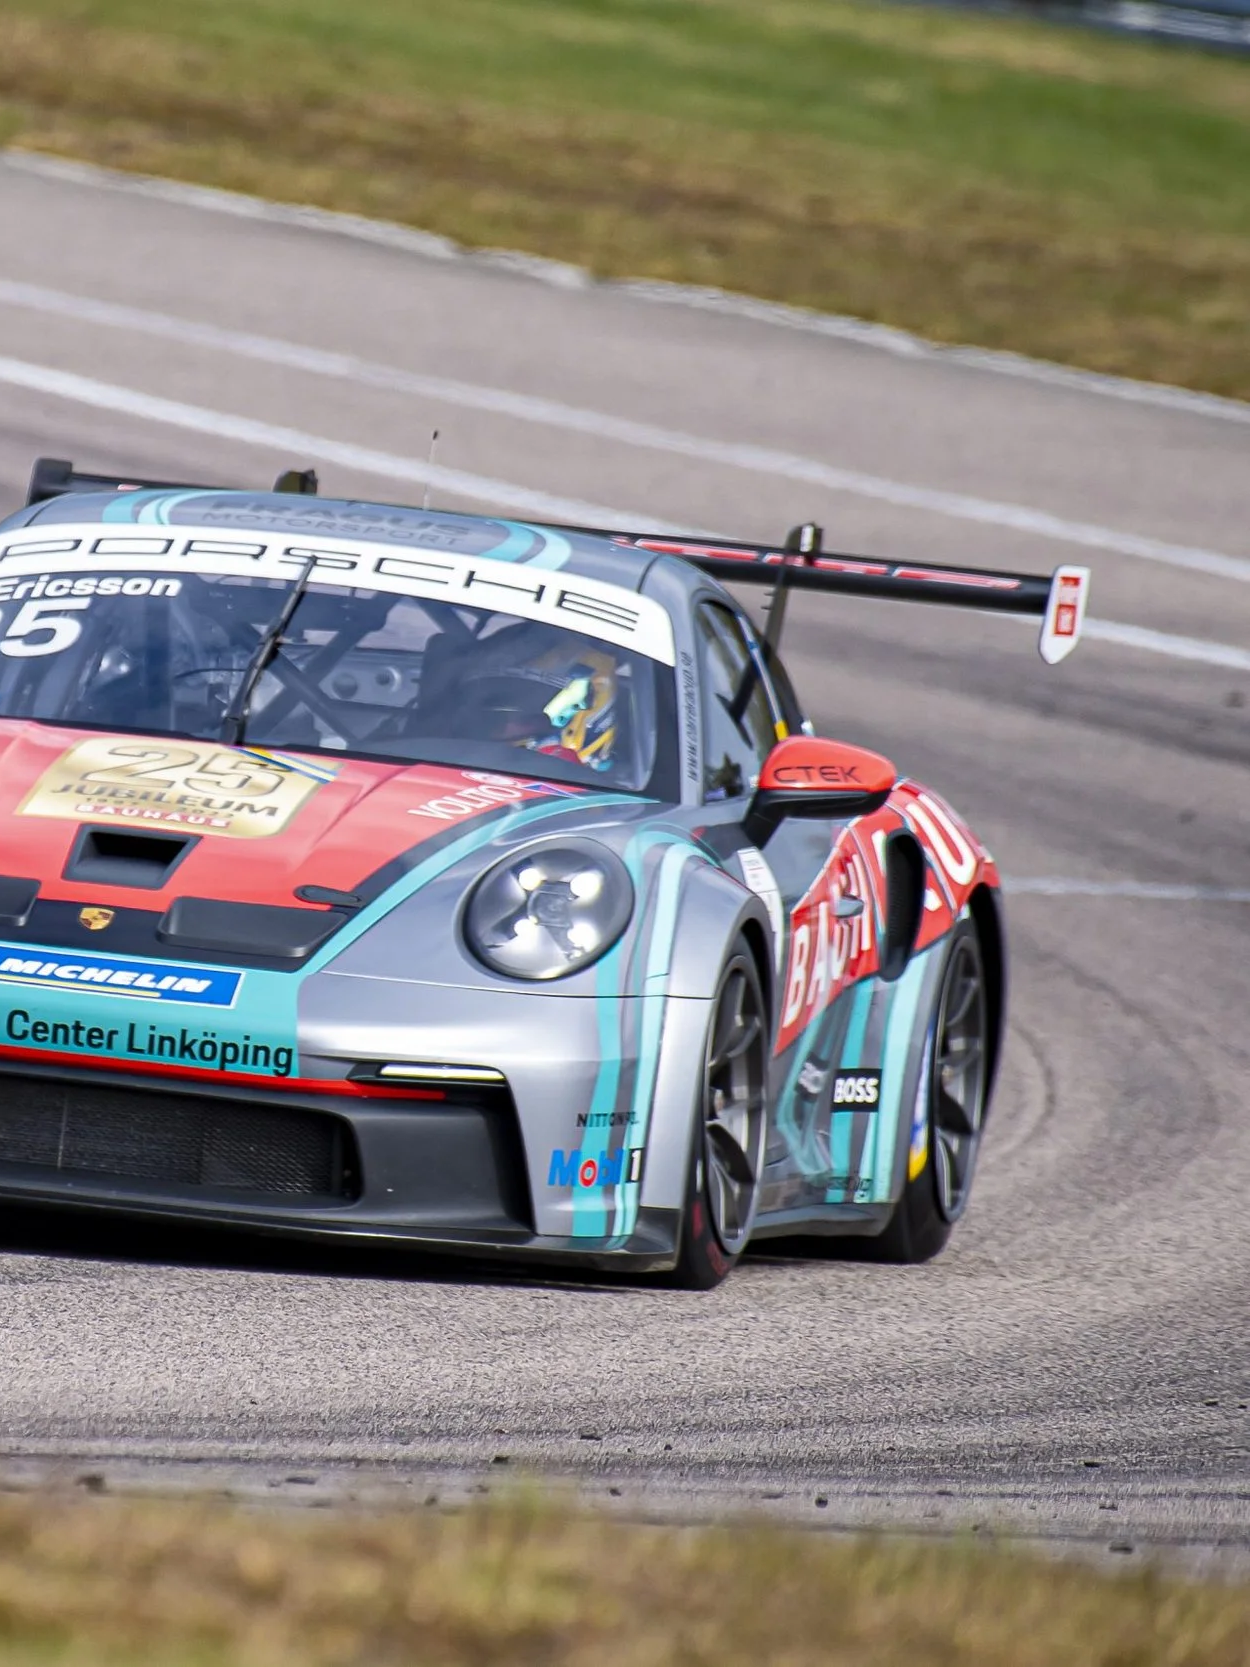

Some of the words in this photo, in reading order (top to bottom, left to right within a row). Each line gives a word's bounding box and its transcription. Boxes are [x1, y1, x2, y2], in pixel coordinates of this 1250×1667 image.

[202, 512, 465, 545] MOTORSPORT
[80, 745, 291, 798] 25
[773, 766, 861, 784] CTEK
[52, 783, 278, 818] JUBILEUM
[75, 803, 230, 828] BAUHAUS
[6, 1009, 119, 1050] Center
[127, 1022, 294, 1078] Linköping
[833, 1077, 879, 1104] BOSS
[547, 1148, 624, 1187] Mobil
[631, 1149, 642, 1182] 1
